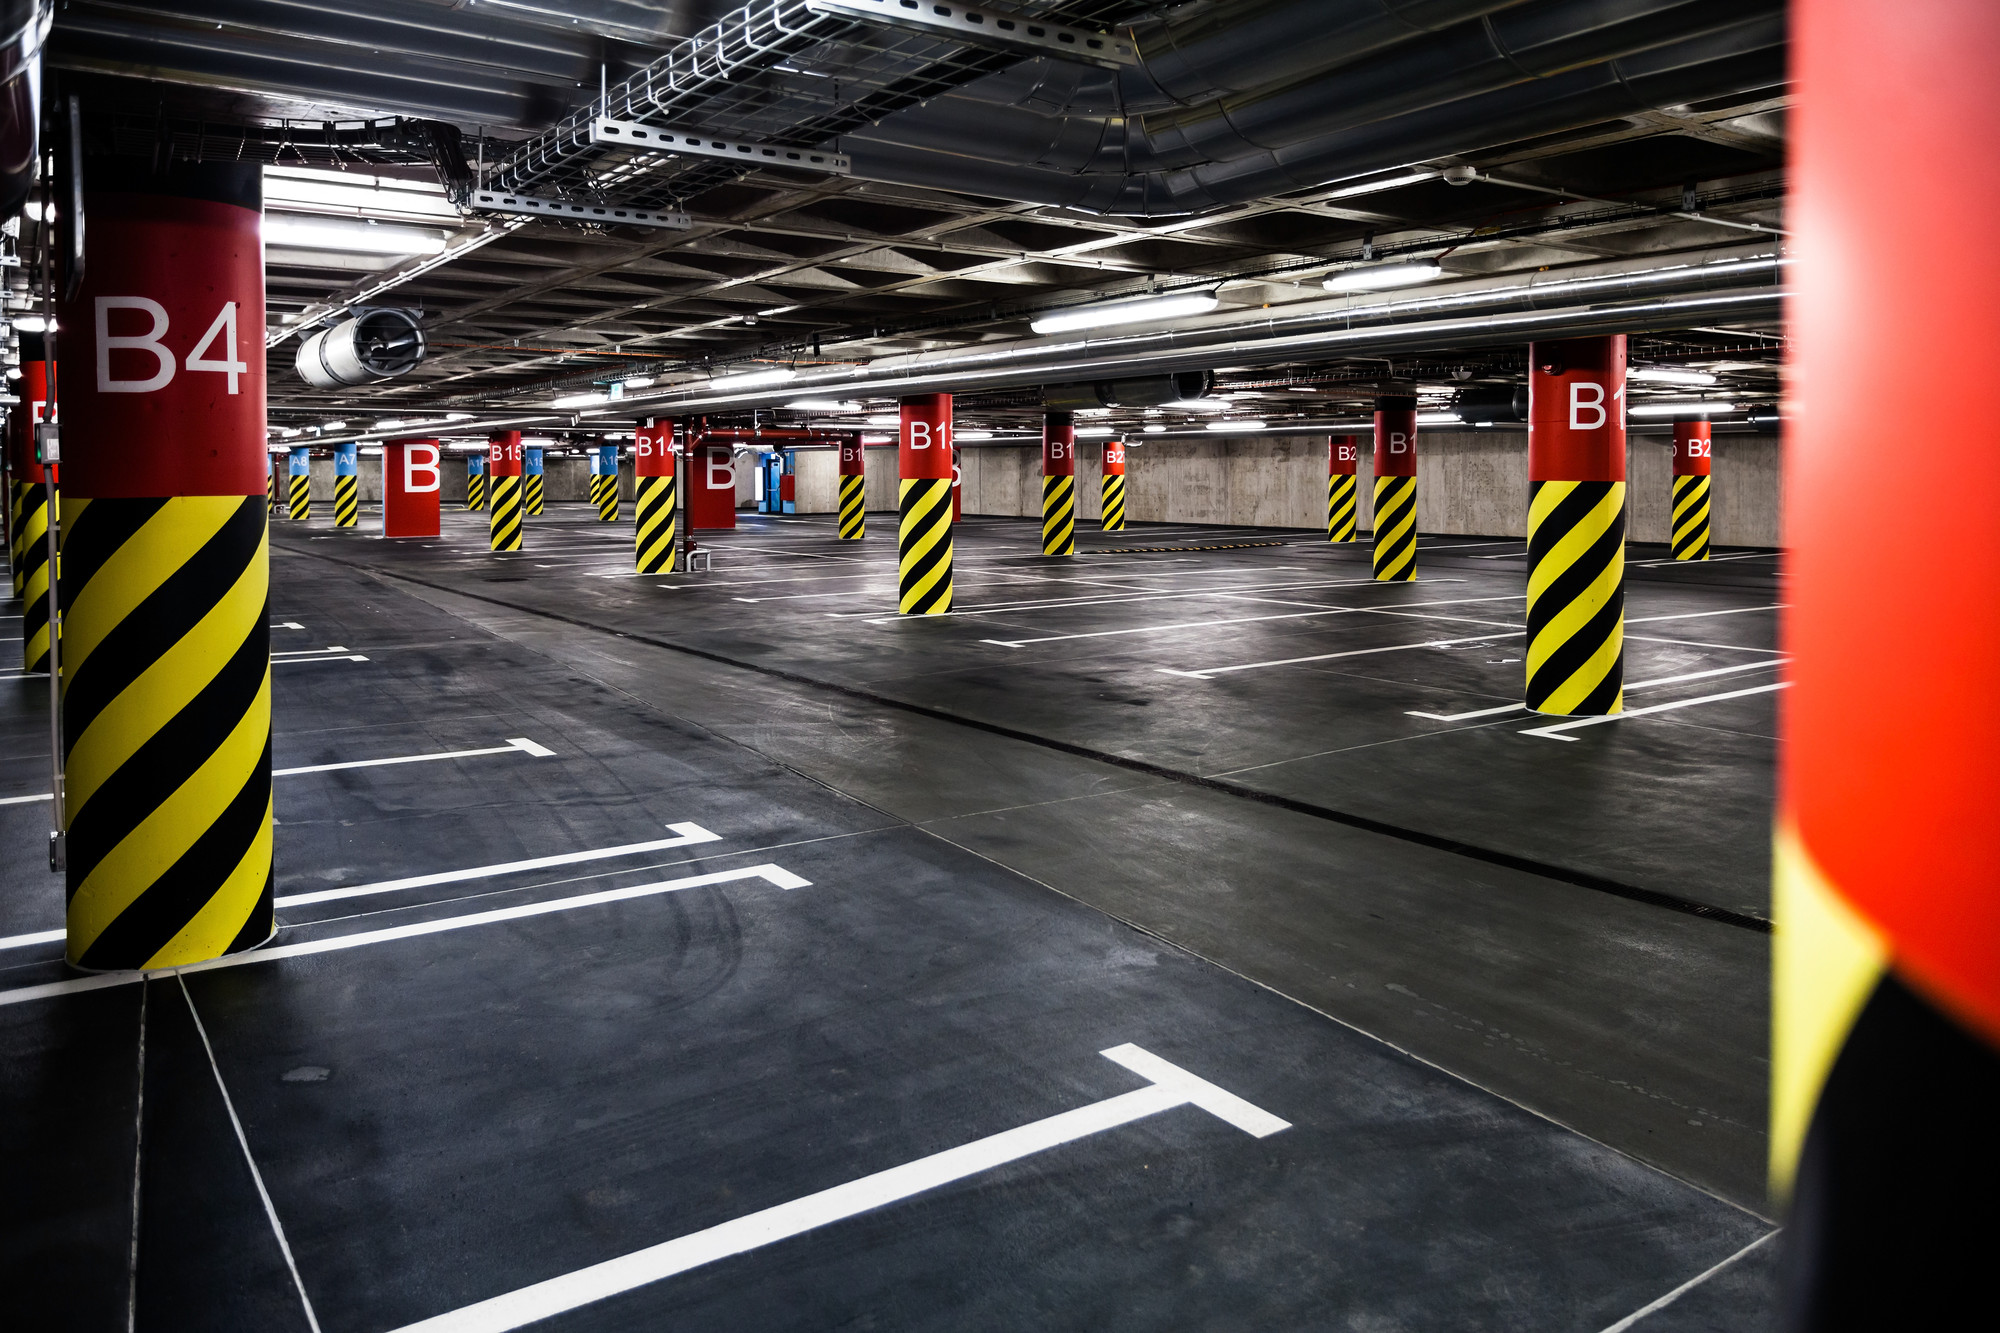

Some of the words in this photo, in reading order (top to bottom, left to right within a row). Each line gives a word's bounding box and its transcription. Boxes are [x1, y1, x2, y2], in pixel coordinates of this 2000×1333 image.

[95, 296, 247, 394] B4
[910, 421, 953, 450] B1
[292, 456, 308, 466] A8
[339, 454, 356, 465] A7
[492, 445, 521, 461] B15
[843, 448, 864, 461] B1
[404, 444, 440, 493] B
[706, 446, 736, 489] B
